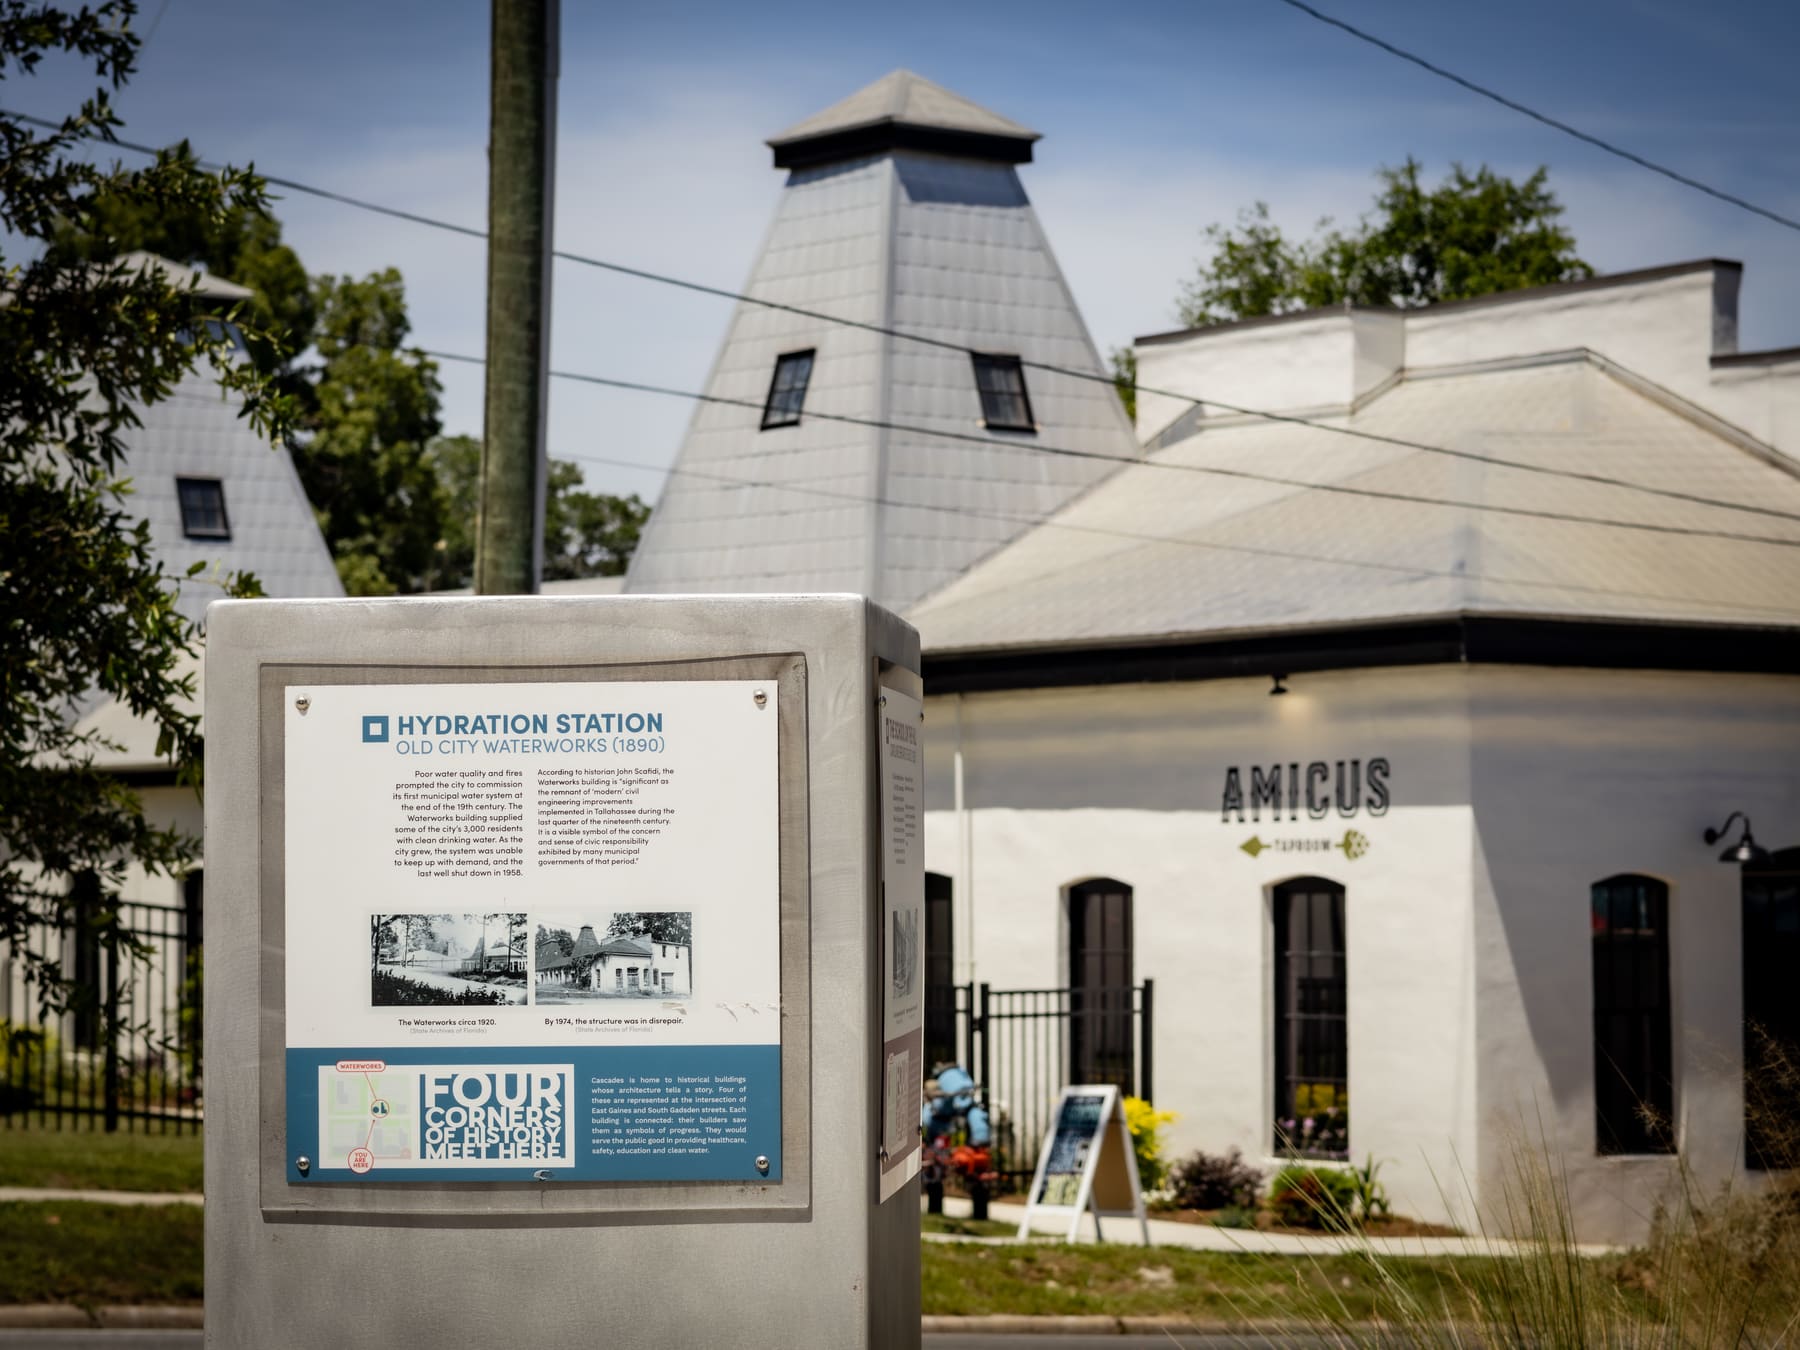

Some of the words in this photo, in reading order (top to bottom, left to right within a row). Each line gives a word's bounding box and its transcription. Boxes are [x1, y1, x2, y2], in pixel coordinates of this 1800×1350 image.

[398, 714, 547, 735] HYDRATION
[556, 712, 662, 733] STATION
[396, 740, 432, 754] OLD
[438, 739, 478, 754] CITY
[482, 738, 607, 753] WATERWORKS
[612, 736, 664, 753] (1890)
[459, 770, 486, 778] quality
[537, 768, 573, 777] According
[616, 768, 632, 776] John
[395, 781, 434, 790] prompted
[451, 781, 465, 789] city
[581, 778, 610, 786] building
[1222, 758, 1390, 822] AMICUS
[420, 792, 459, 801] municipal
[475, 803, 506, 811] century.
[537, 798, 580, 807] engineering
[538, 808, 584, 816] implemented
[638, 808, 661, 816] during
[455, 814, 487, 823] building
[489, 813, 522, 822] supplied
[582, 828, 608, 836] symbol
[438, 836, 470, 845] drinking
[602, 837, 648, 846] responsibility
[394, 848, 409, 856] city
[449, 848, 476, 856] system
[404, 858, 423, 867] keep
[455, 858, 490, 866] demand,
[648, 1017, 683, 1025] disrepair.
[714, 1075, 746, 1084] buildings
[425, 1073, 562, 1107] FOUR
[425, 1106, 562, 1128] CORNERS
[425, 1127, 456, 1144] OF
[464, 1126, 562, 1144] HISTORY
[426, 1142, 490, 1159] MEET
[499, 1142, 561, 1159] HERE
